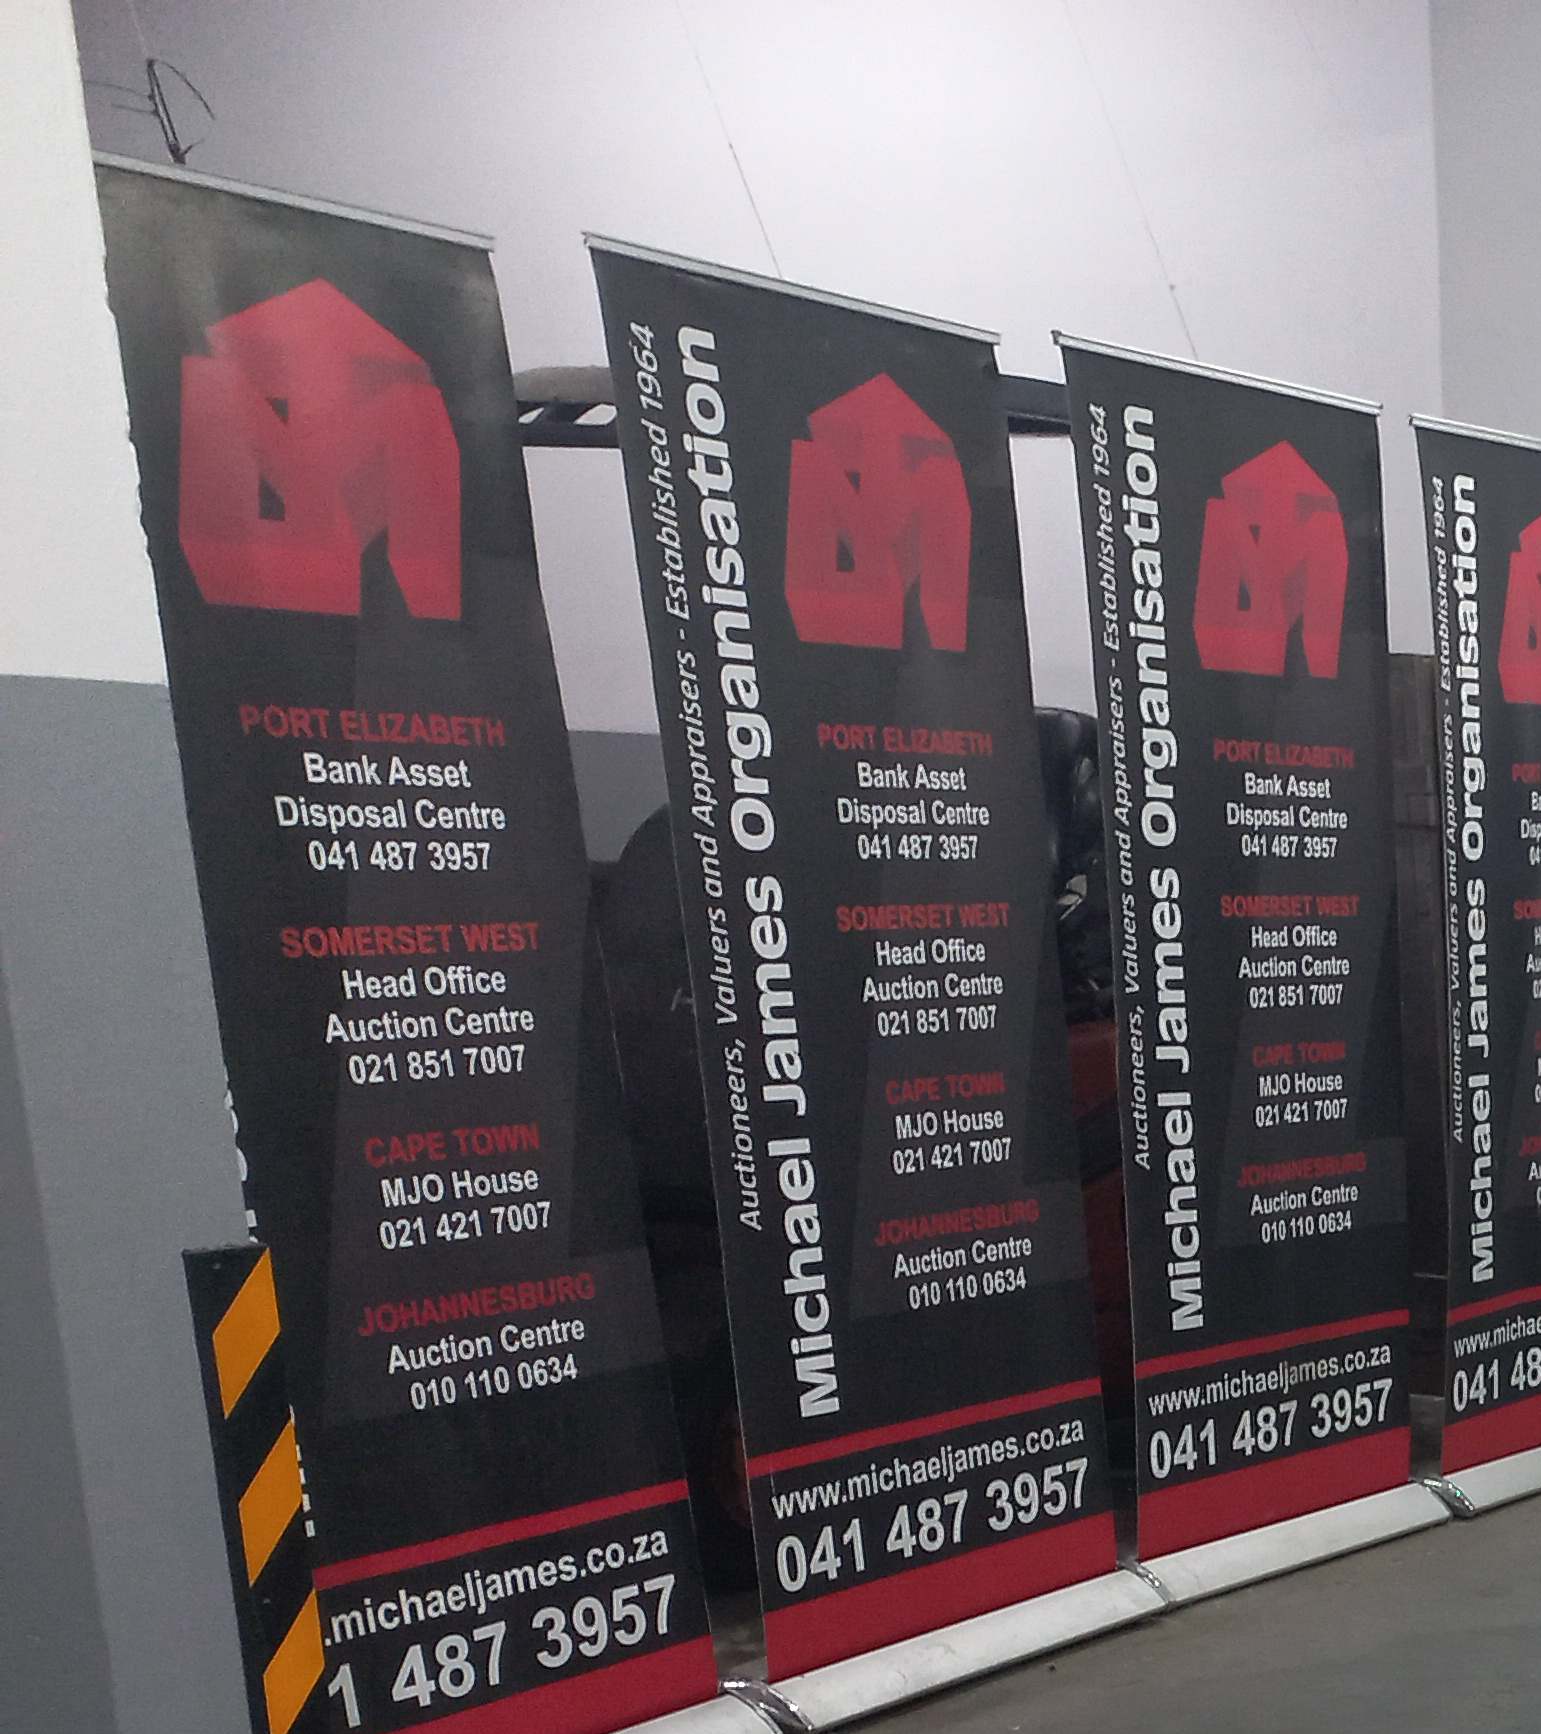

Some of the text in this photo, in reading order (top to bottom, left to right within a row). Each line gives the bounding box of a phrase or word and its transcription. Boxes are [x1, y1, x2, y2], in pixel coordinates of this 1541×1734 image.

[239, 704, 506, 746] PORT ELIZABETH
[303, 752, 471, 787] Bank Asset
[630, 321, 763, 1231] Auctioneers, Valuers and Appraisers Established 1964
[857, 761, 967, 791] Bank Asset
[1089, 402, 1151, 1171] Auctioneers, Valuers and Appraisers Established 1964
[1244, 772, 1331, 798] Bank Asset
[275, 796, 506, 834] Disposal Centre
[837, 797, 990, 829] Disposal Centre
[1227, 802, 1348, 830] Disposal Centre
[308, 840, 490, 870] 041 487 3957
[857, 834, 978, 860] 041 487 3957
[1242, 834, 1337, 858] 041 487 3957
[677, 325, 841, 1418] Michael James Organisation
[1121, 404, 1205, 1332] Michael James Organisation
[1451, 474, 1493, 1283] Michael James Organisation
[280, 922, 539, 958] SOMERSET WEST
[876, 937, 986, 965] Head Office
[1251, 925, 1338, 948] Head Office
[341, 966, 507, 999] Head Office
[1239, 954, 1350, 979] Auction Centre
[862, 973, 1003, 1002] Auction Centre
[1249, 984, 1343, 1008] 021 851 7007
[326, 1006, 534, 1043] Auction Centre
[877, 1004, 997, 1037] 021 851 7007
[349, 1044, 525, 1084] 021 851 7007
[1259, 1072, 1342, 1098] MJO House
[895, 1109, 1004, 1140] MJO House
[1256, 1099, 1348, 1128] 021 421 7007
[364, 1121, 540, 1168] CAPE TOWN
[892, 1137, 1012, 1175] 021 421 7007
[380, 1168, 539, 1208] MJO House
[1250, 1184, 1359, 1216] Auction Centre
[379, 1201, 551, 1250] 021 421 7007
[1261, 1211, 1351, 1243] 010 110 0634
[893, 1235, 1032, 1279] Auction Centre
[358, 1272, 596, 1336] JOHANNESBURG
[909, 1266, 1027, 1310] 010 110 0634
[387, 1317, 585, 1375] Auction Centre
[410, 1353, 578, 1411] 010 110 0634
[1149, 1344, 1391, 1416] www.michaeljames.co.za
[1453, 1359, 1499, 1412] 041
[1149, 1378, 1393, 1480] 041 487 3957
[771, 1418, 1085, 1520] www.michaeljames.co.za
[776, 1457, 1088, 1593] 041 487 3957
[391, 1620, 507, 1707] 487
[531, 1573, 676, 1668] 3957
